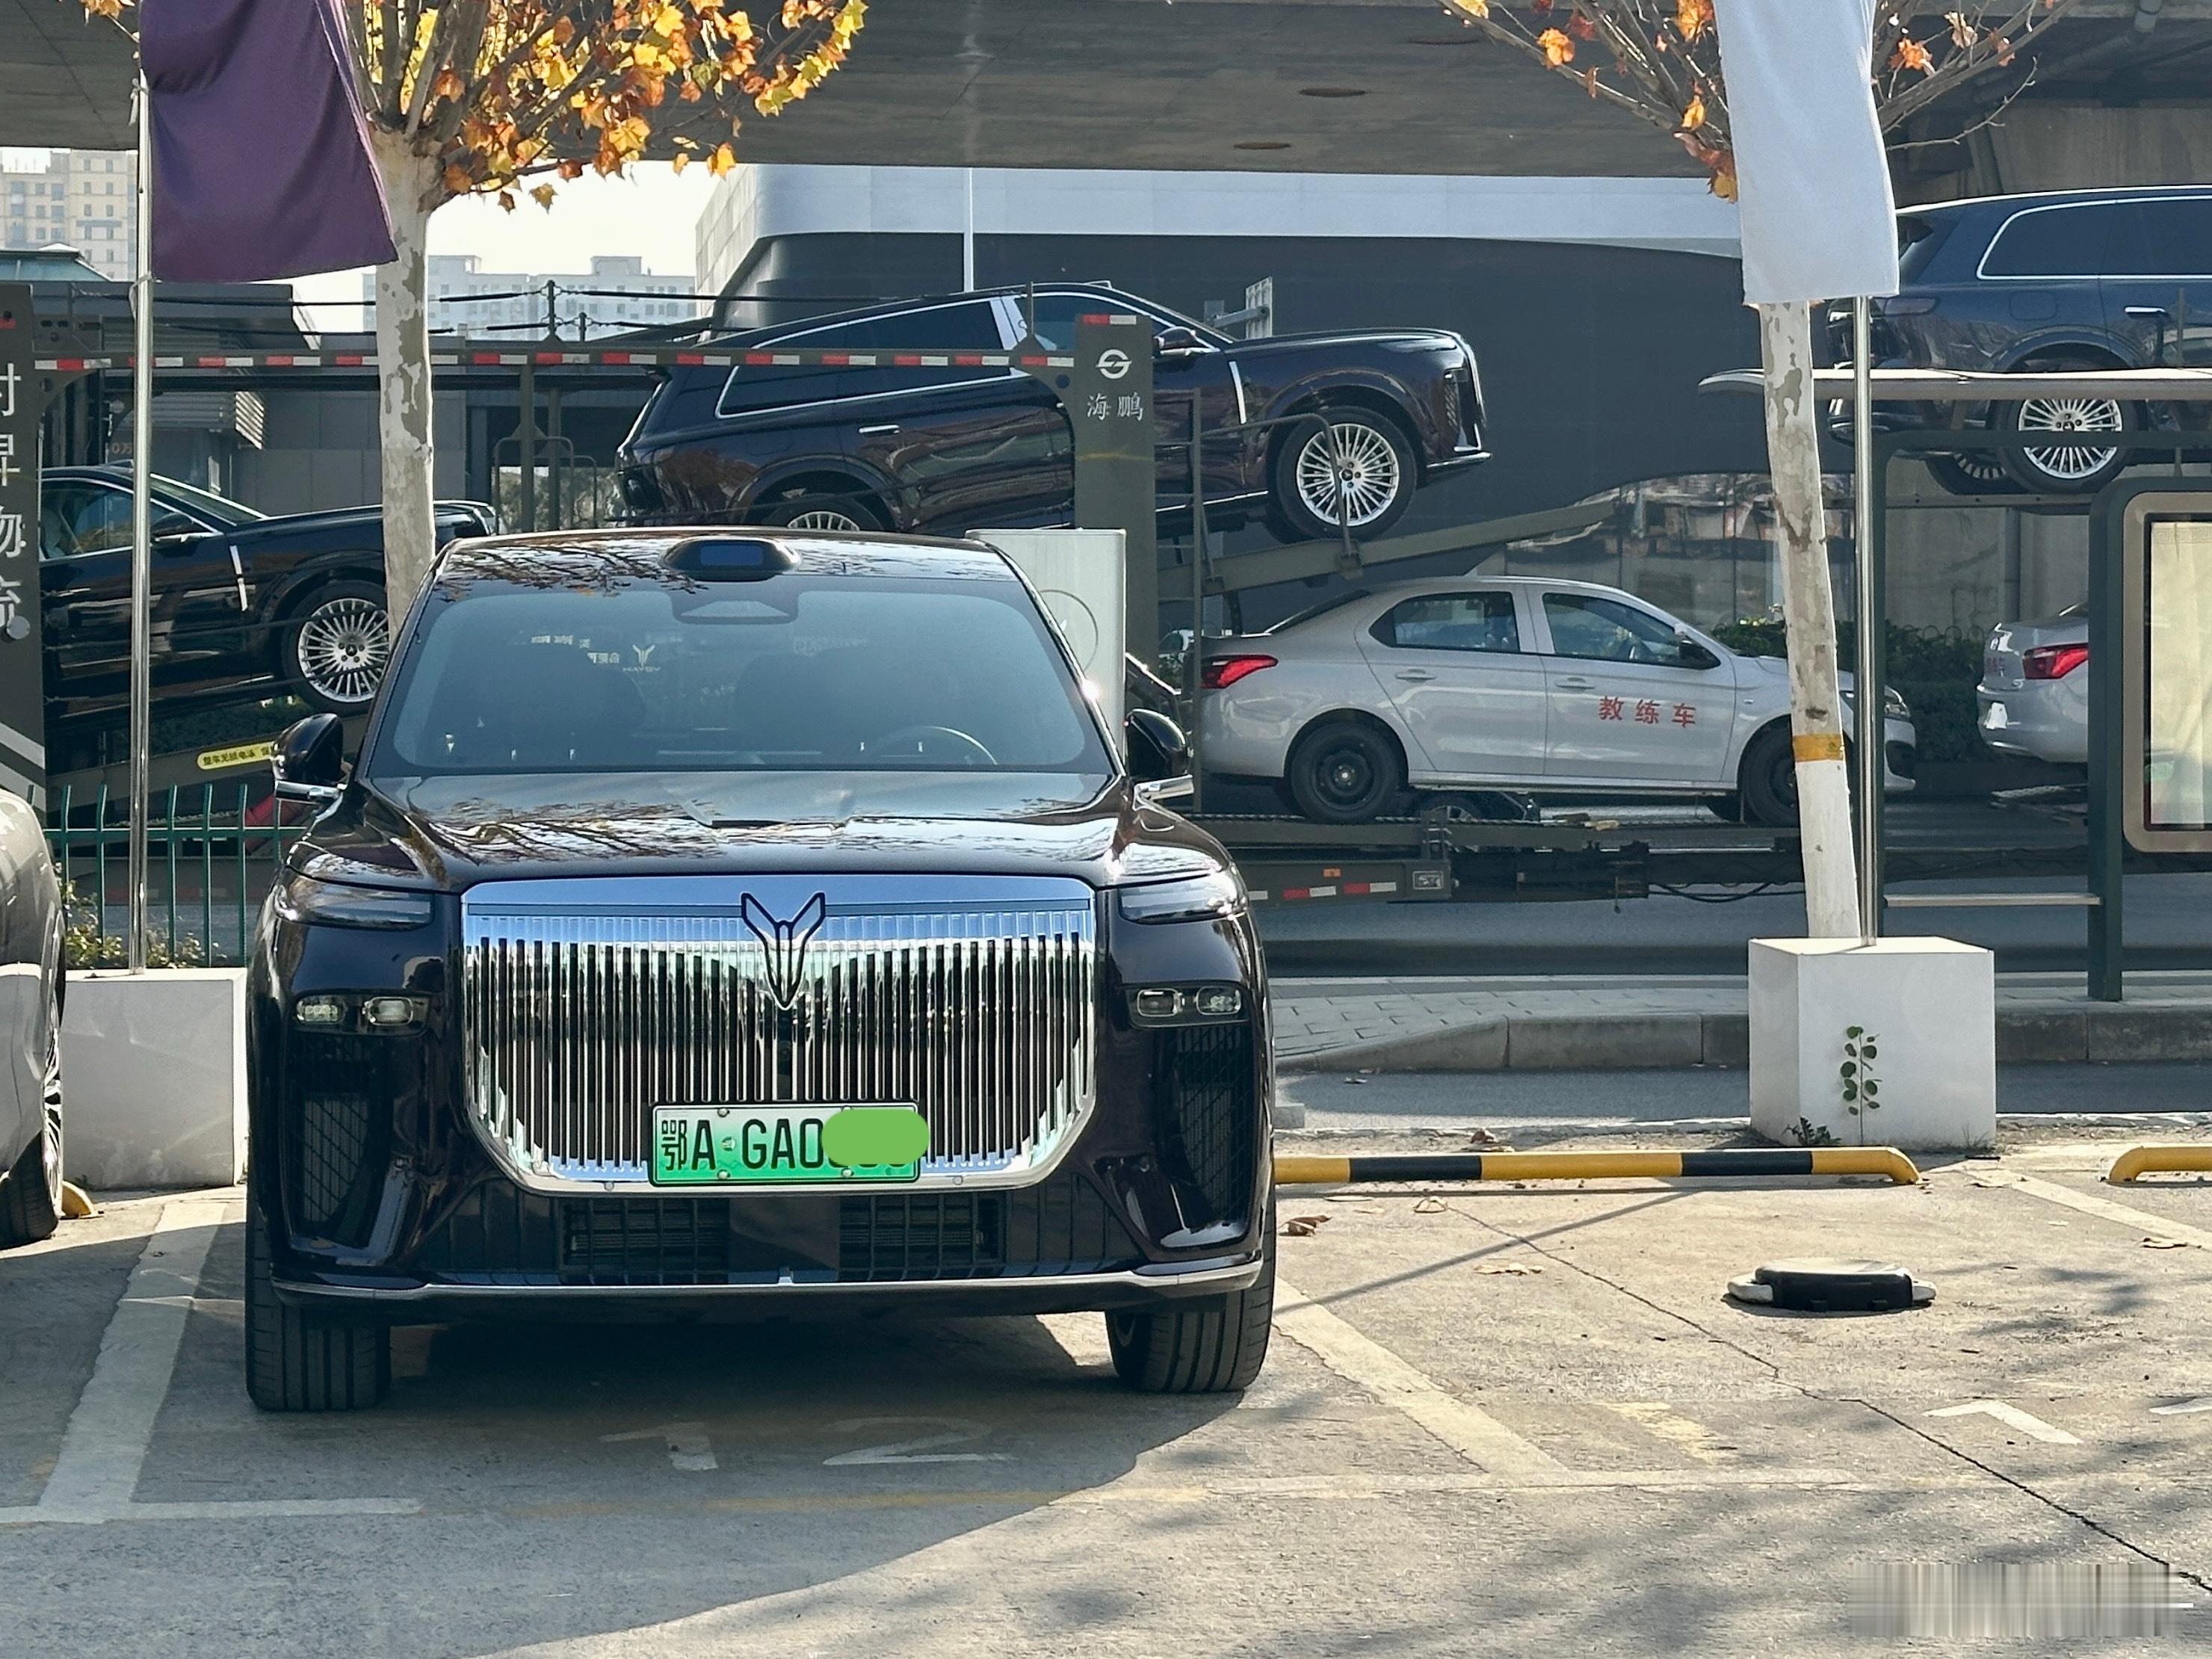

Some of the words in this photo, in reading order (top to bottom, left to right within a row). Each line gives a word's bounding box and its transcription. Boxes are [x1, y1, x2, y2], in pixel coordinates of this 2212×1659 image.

[1087, 392, 1143, 421] 海鹏
[1599, 696, 1696, 727] 教练车
